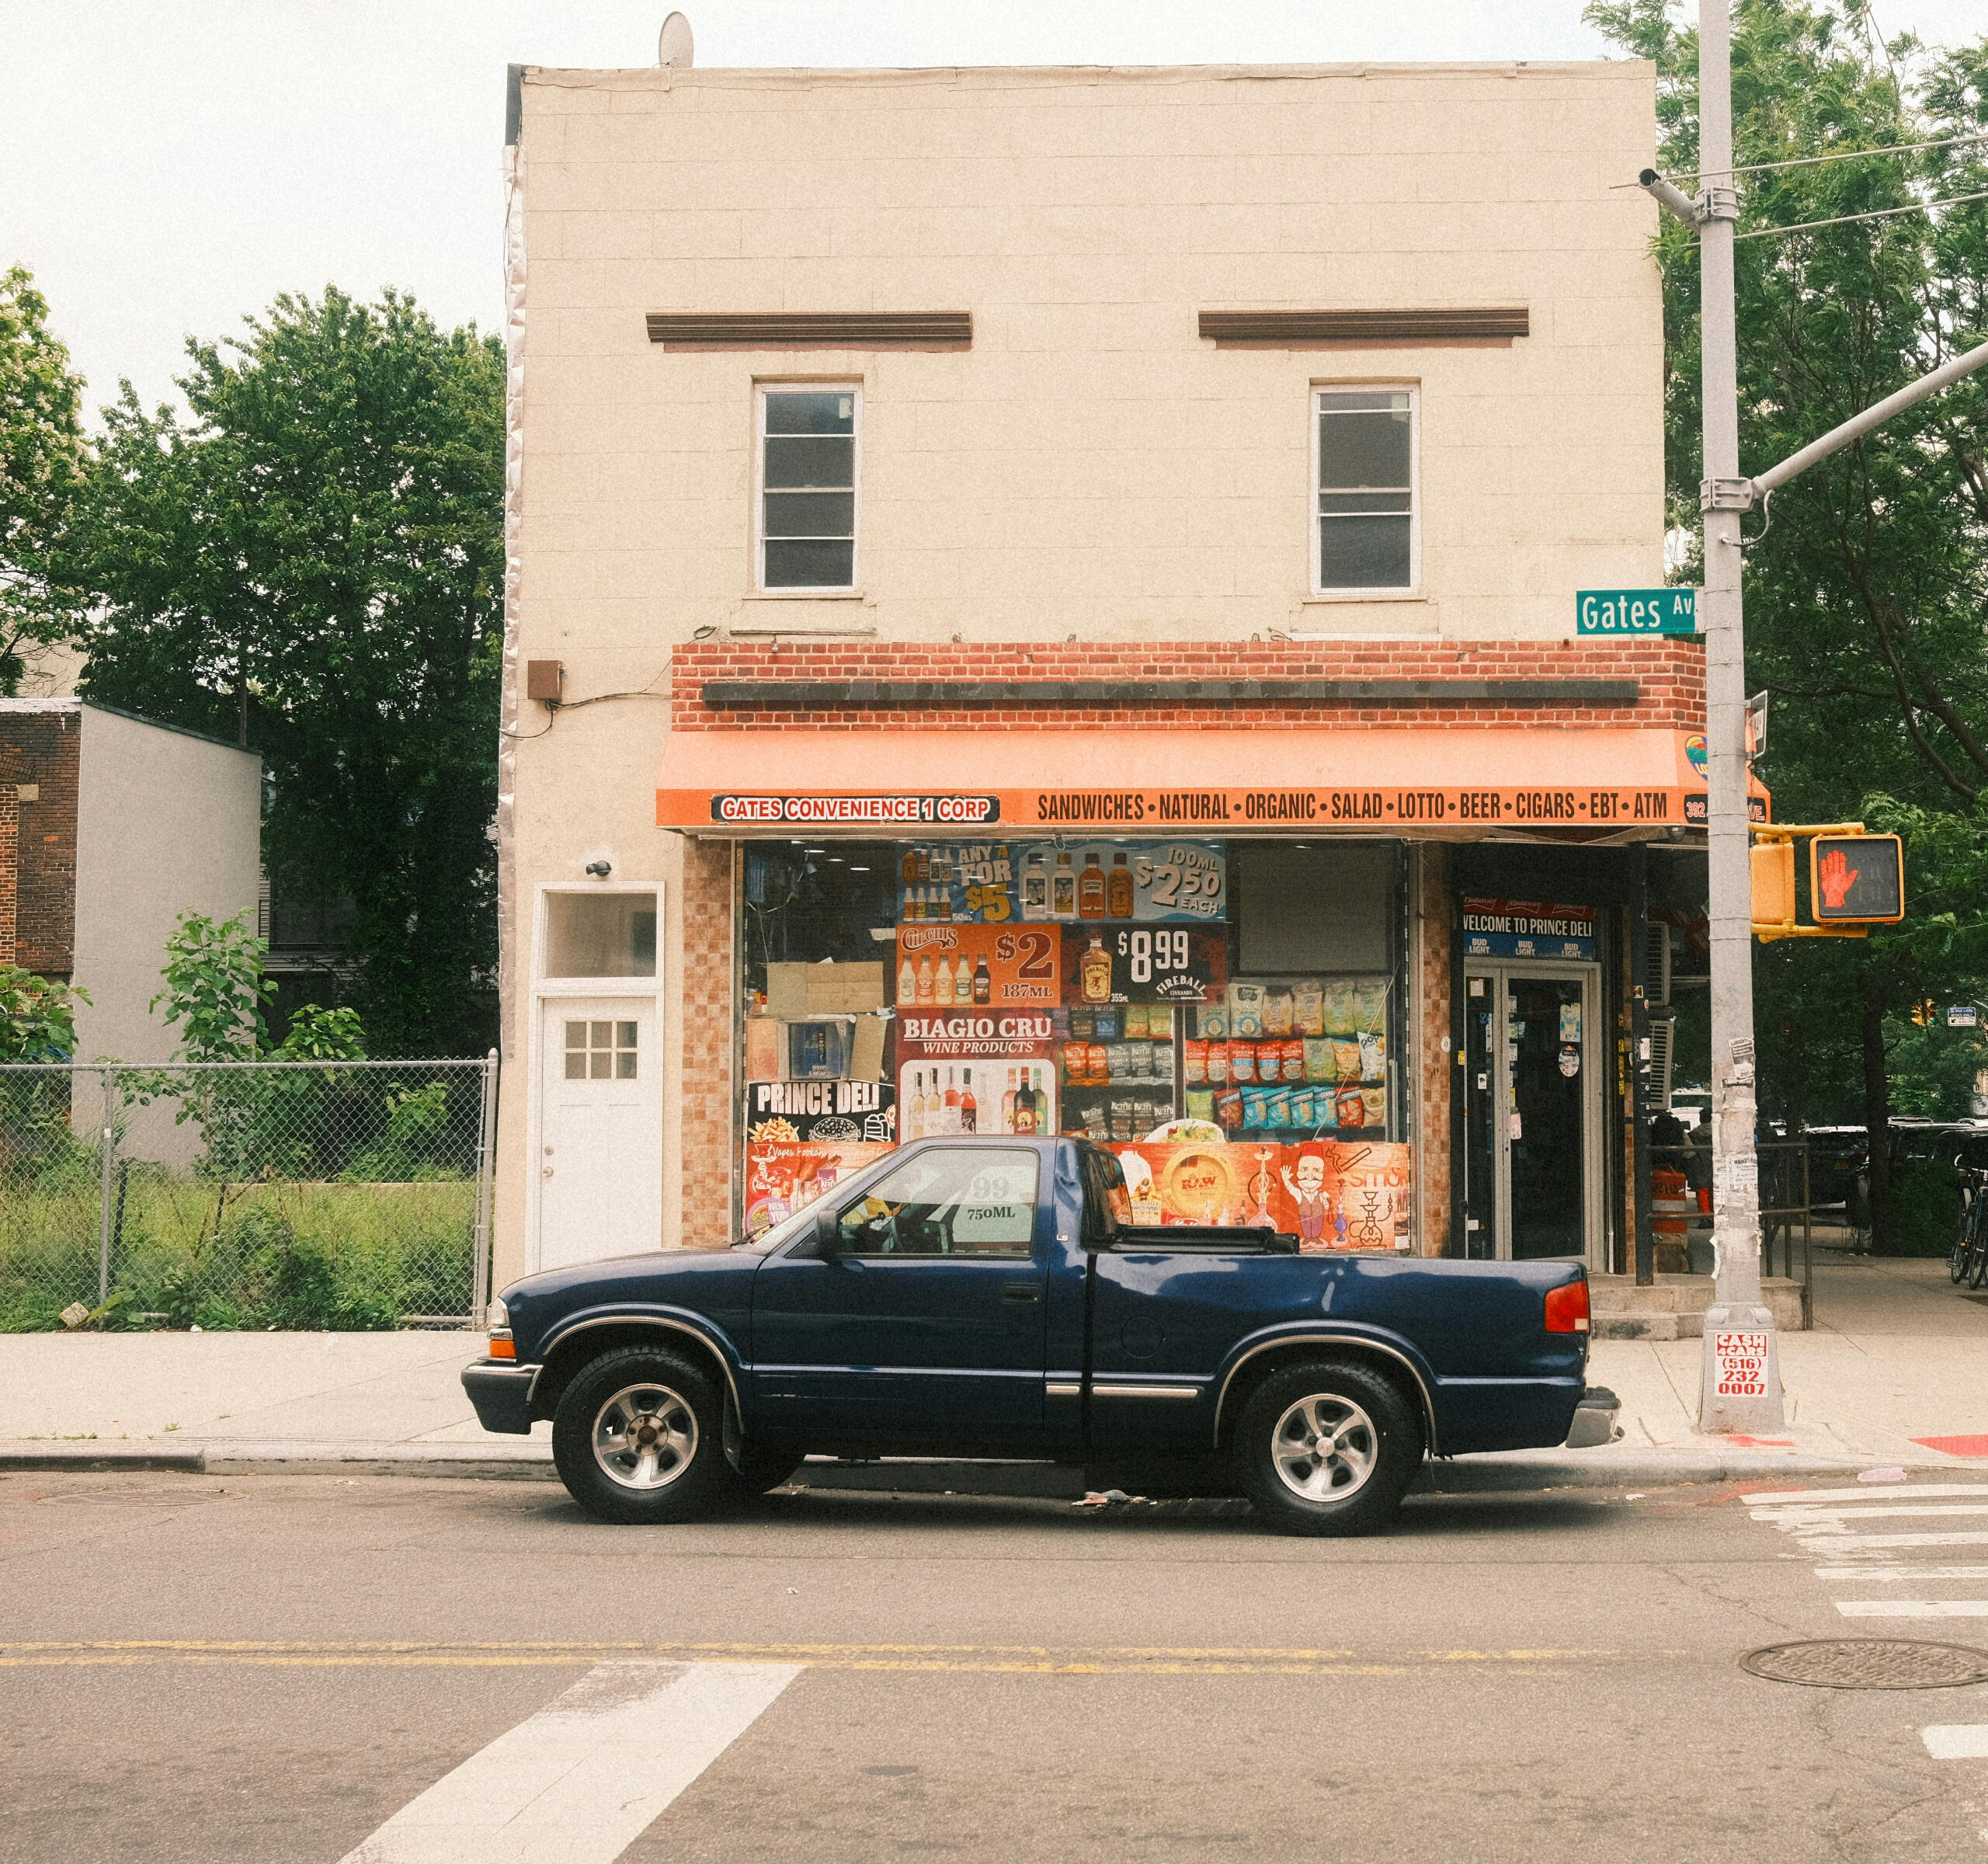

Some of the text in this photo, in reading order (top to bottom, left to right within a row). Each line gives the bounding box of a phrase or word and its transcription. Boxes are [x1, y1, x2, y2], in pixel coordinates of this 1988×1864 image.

[1582, 594, 1692, 629] Gates Av
[721, 796, 992, 820] GATES CONVENIENCE 1 CORP
[1037, 792, 1667, 820] SANDWICHES NATURAL ORGANIC SALAD LOTTO BEER CIGARS EBT ATM
[1686, 802, 1706, 818] 392
[958, 846, 992, 864] ANY
[1168, 847, 1218, 871] 100ML
[960, 860, 1012, 886] FOR
[966, 883, 1011, 921] $5
[1180, 899, 1220, 913] EACH
[1514, 917, 1527, 934] TO
[1530, 919, 1567, 936] PRINCE
[1570, 921, 1592, 937] DELI
[996, 931, 1055, 979] $2
[1516, 948, 1535, 957] LIGHT
[1002, 982, 1054, 998] 187ML
[1156, 975, 1207, 996] FIREBALL
[1110, 993, 1129, 1003] 355ML
[904, 1017, 1052, 1038] BIAGIO CRU
[923, 1041, 1034, 1054] WINE PRODUCTS
[757, 1082, 880, 1115] PRINCE DELI
[1181, 1177, 1217, 1190] RAW
[968, 1206, 1016, 1220] 750ML
[1718, 1334, 1765, 1347] CASH
[1722, 1358, 1762, 1369] (516)
[1724, 1370, 1759, 1382] 232
[1719, 1382, 1765, 1395] 0007
